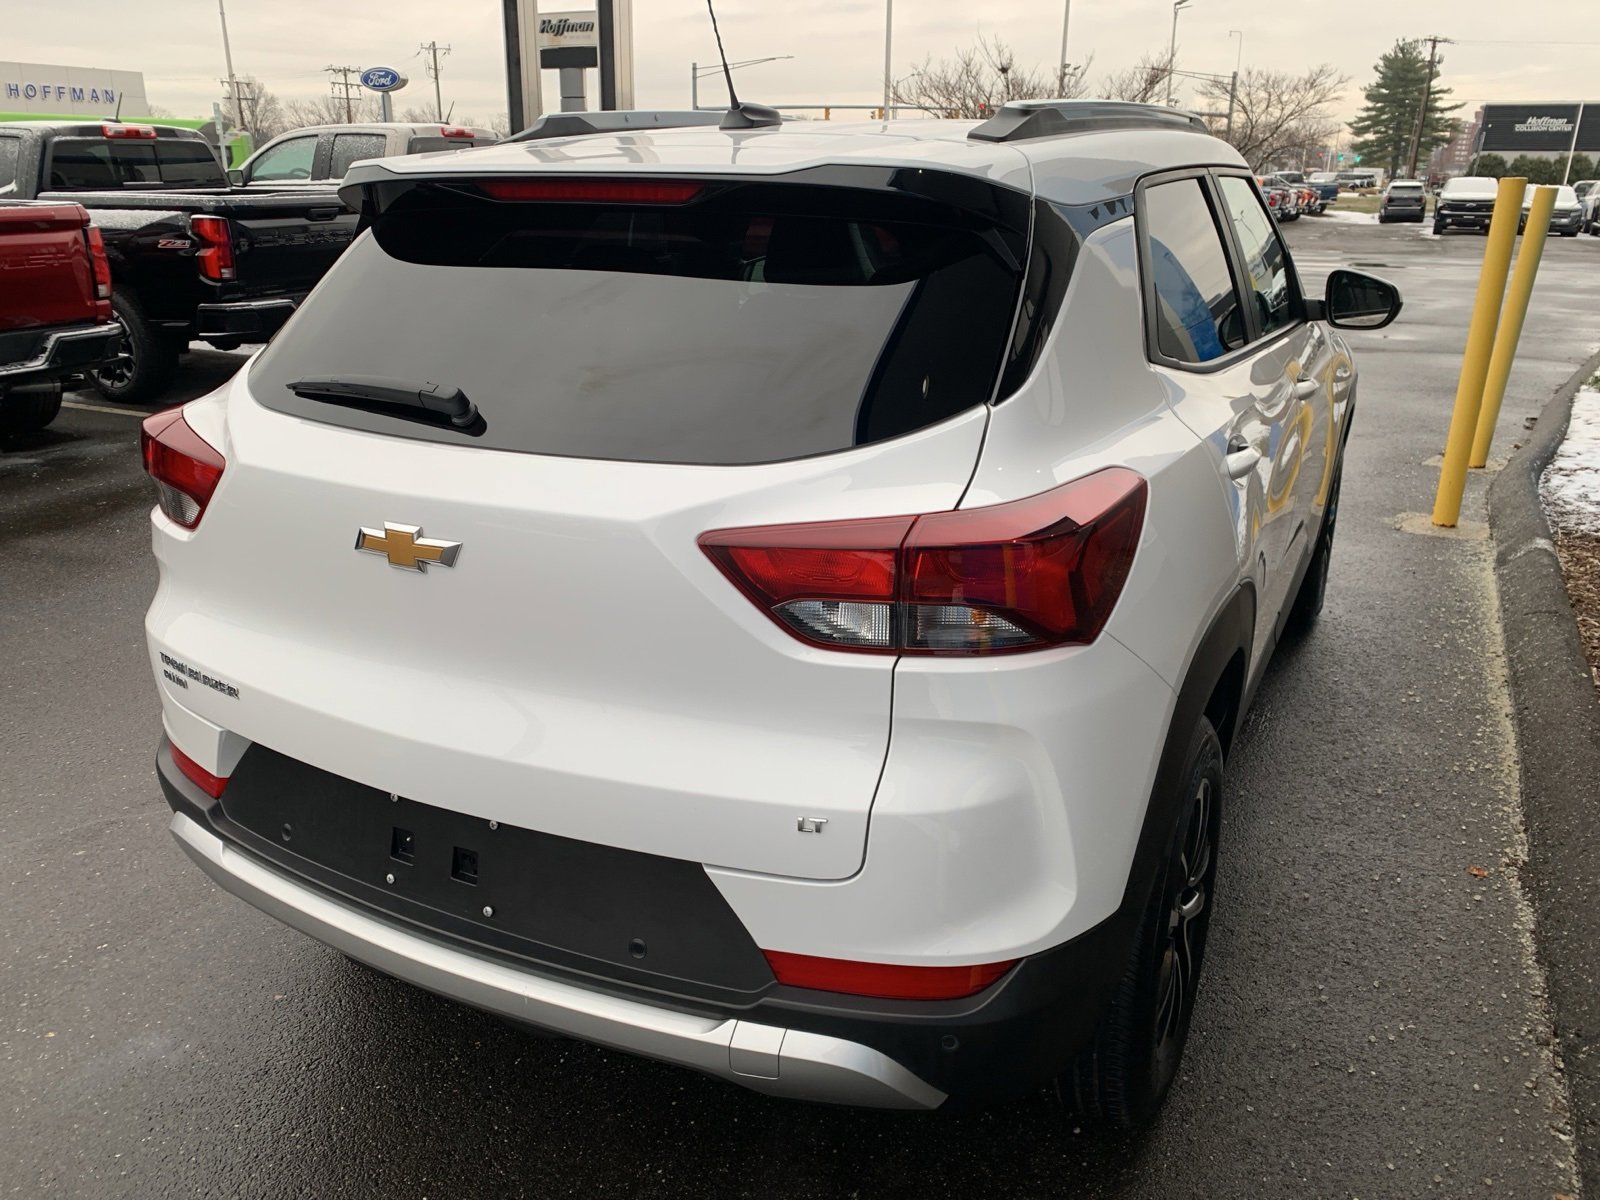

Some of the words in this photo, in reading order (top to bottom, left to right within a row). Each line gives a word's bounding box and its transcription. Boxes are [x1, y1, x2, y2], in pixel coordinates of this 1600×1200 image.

[539, 18, 595, 37] Hoffman
[368, 71, 392, 86] Ford
[7, 82, 116, 104] HOFFMAN
[1525, 116, 1568, 126] Hoffman
[797, 816, 829, 833] LT
